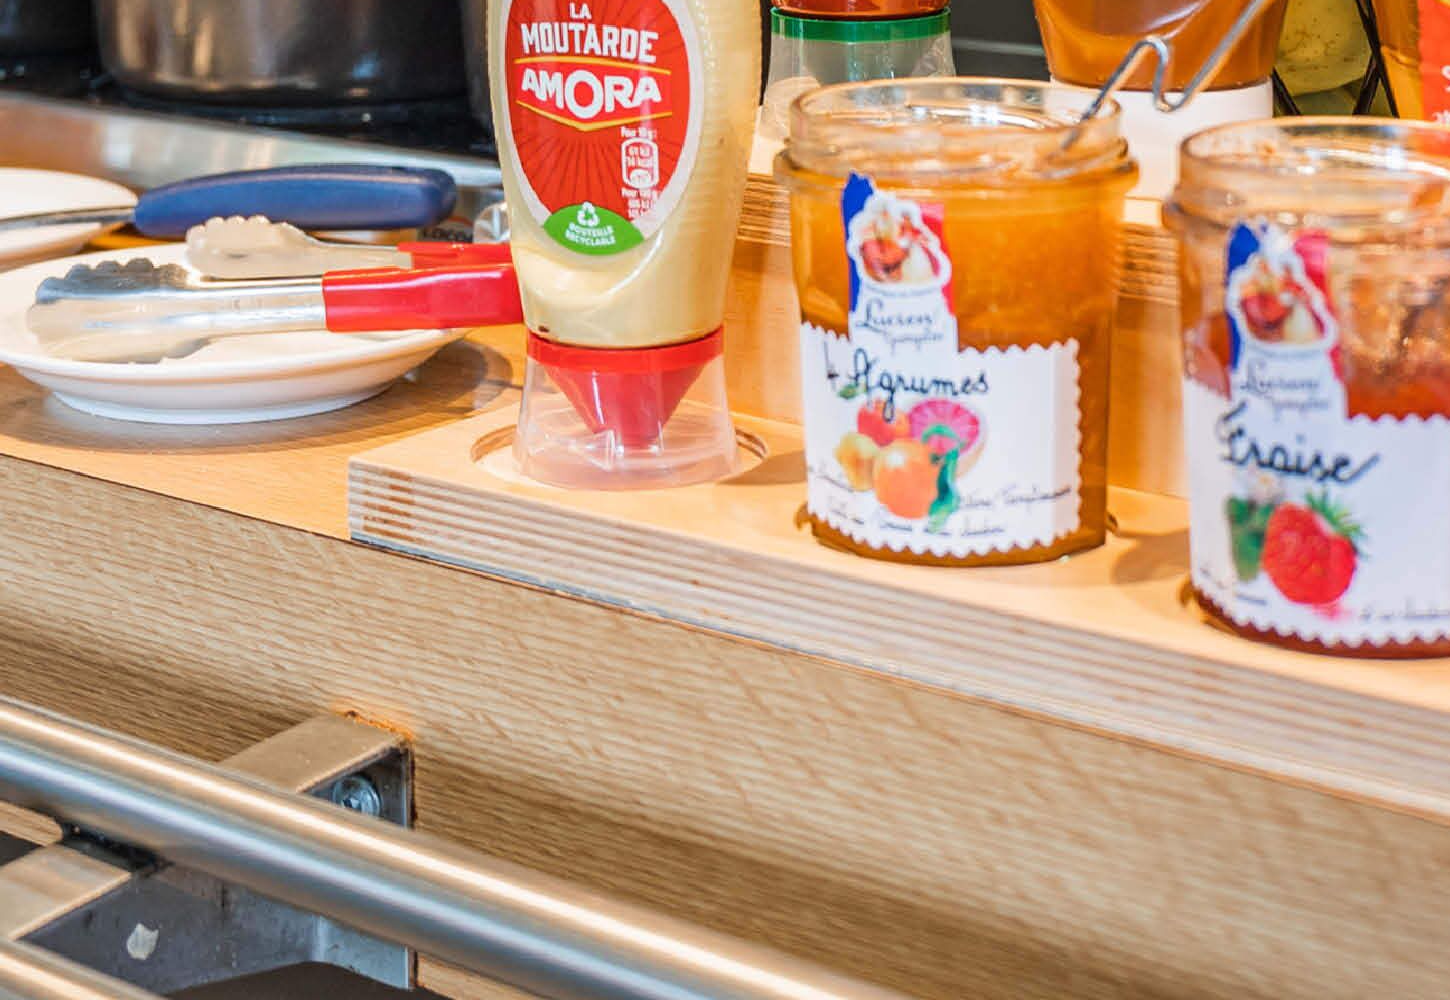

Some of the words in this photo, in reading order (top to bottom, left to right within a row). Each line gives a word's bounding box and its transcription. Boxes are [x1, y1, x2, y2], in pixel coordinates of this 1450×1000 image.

[569, 2, 592, 20] LA
[520, 22, 660, 64] MOUTARDE
[521, 68, 662, 120] AMORA
[847, 348, 989, 421] Agrumes
[1216, 400, 1380, 484] Fraise
